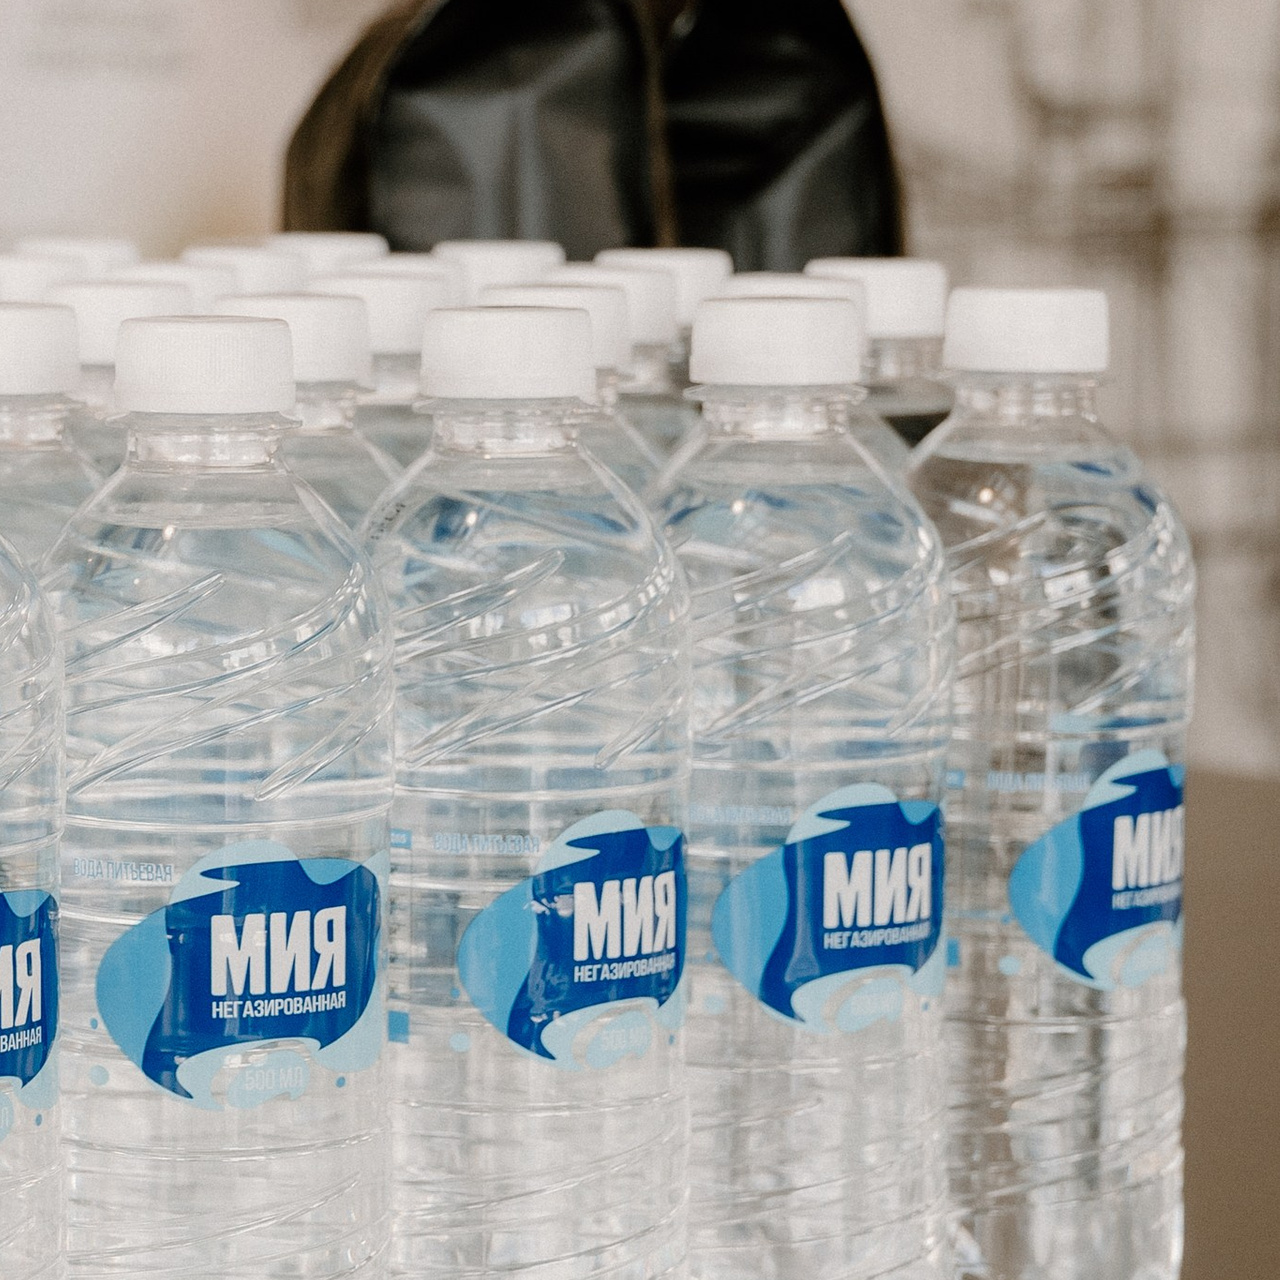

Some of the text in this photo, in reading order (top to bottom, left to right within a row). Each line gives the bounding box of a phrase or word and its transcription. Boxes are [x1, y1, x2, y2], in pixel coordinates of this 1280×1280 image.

[73, 857, 173, 882] ВОДА ПИТЬЕВАЯ
[823, 842, 932, 929] МИЯ
[210, 906, 346, 996] МИЯ
[573, 870, 676, 961] МИЯ
[211, 990, 346, 1019] НЕГАЗИРОВАННАЯ
